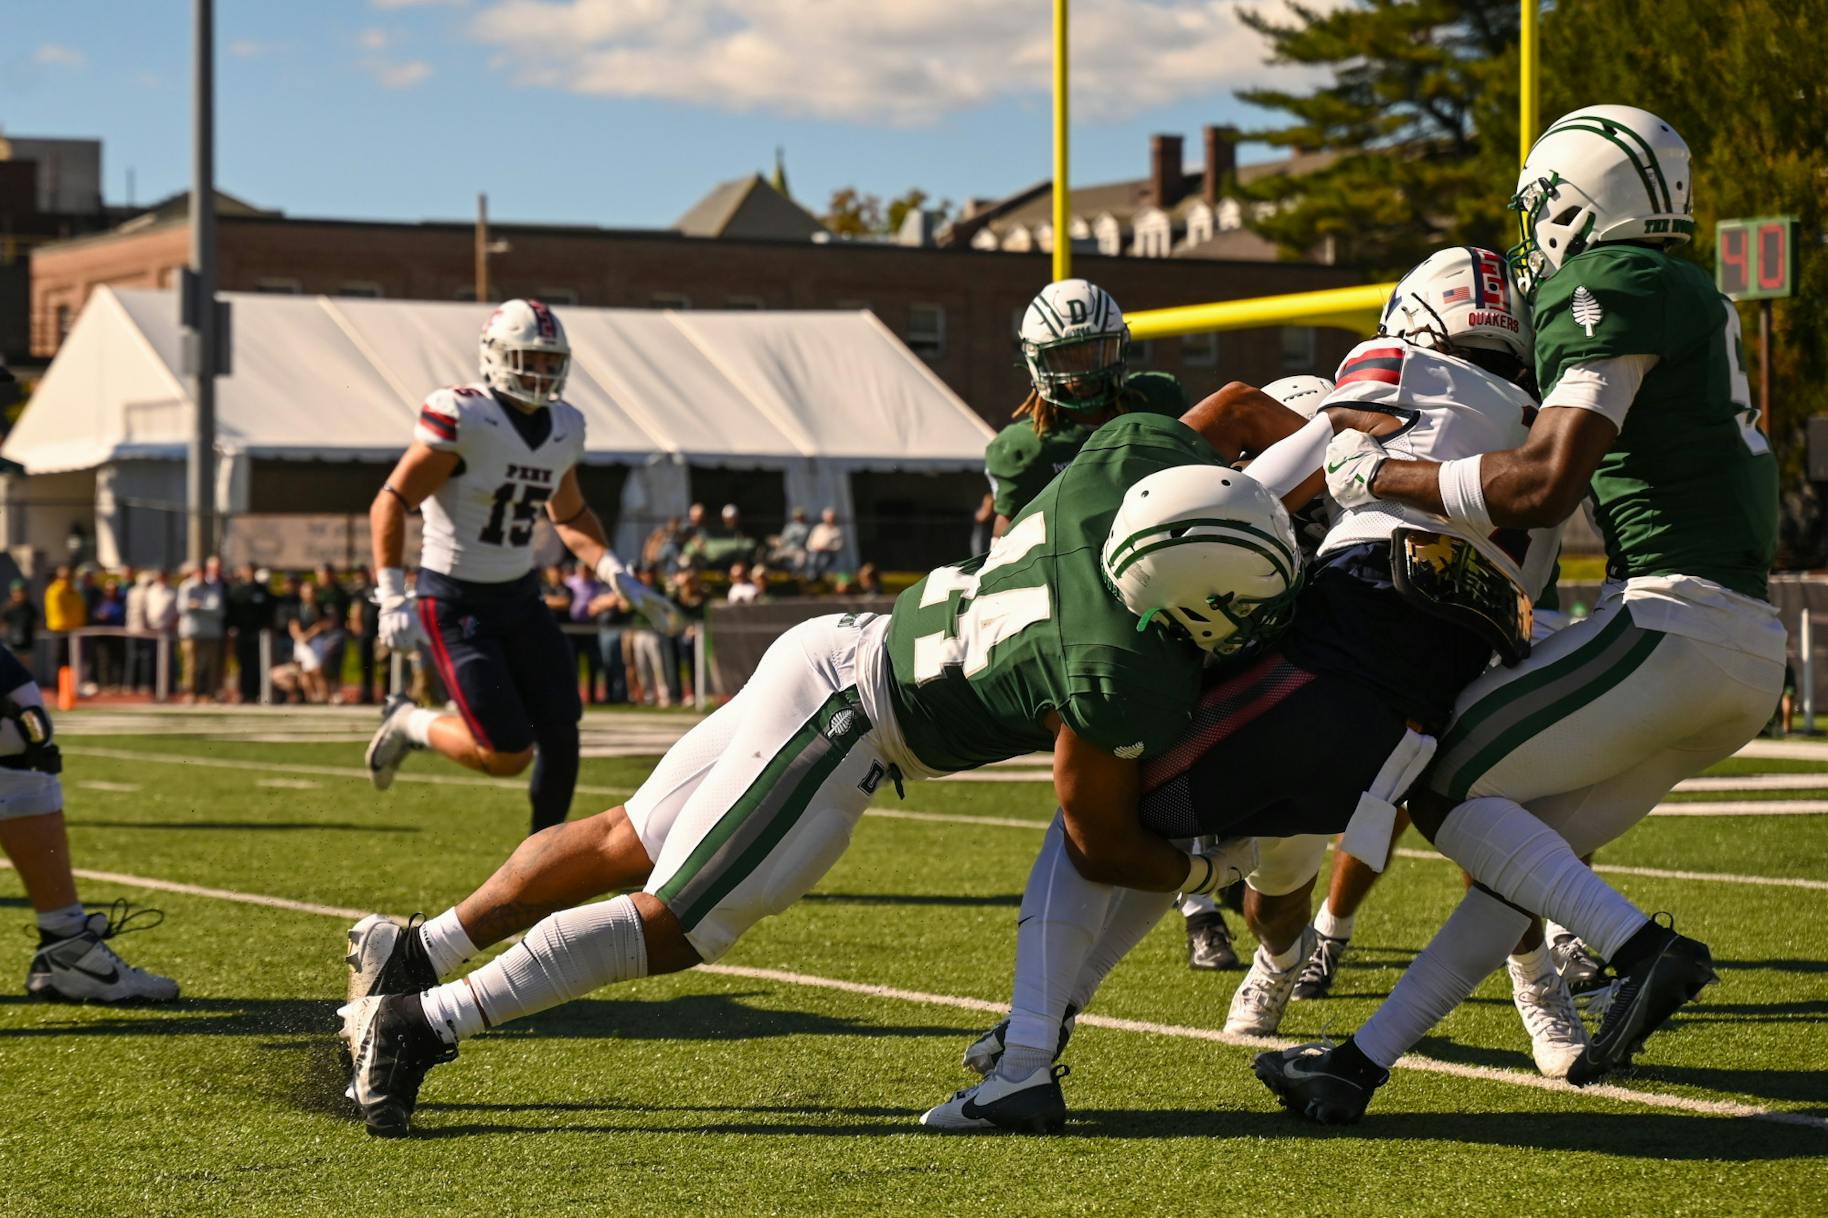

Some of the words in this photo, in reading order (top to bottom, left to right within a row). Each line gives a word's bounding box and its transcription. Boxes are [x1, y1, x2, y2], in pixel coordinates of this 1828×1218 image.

[1722, 224, 1784, 288] 40
[1066, 299, 1087, 325] D
[1468, 312, 1520, 334] QUAKERS
[478, 481, 554, 548] 15
